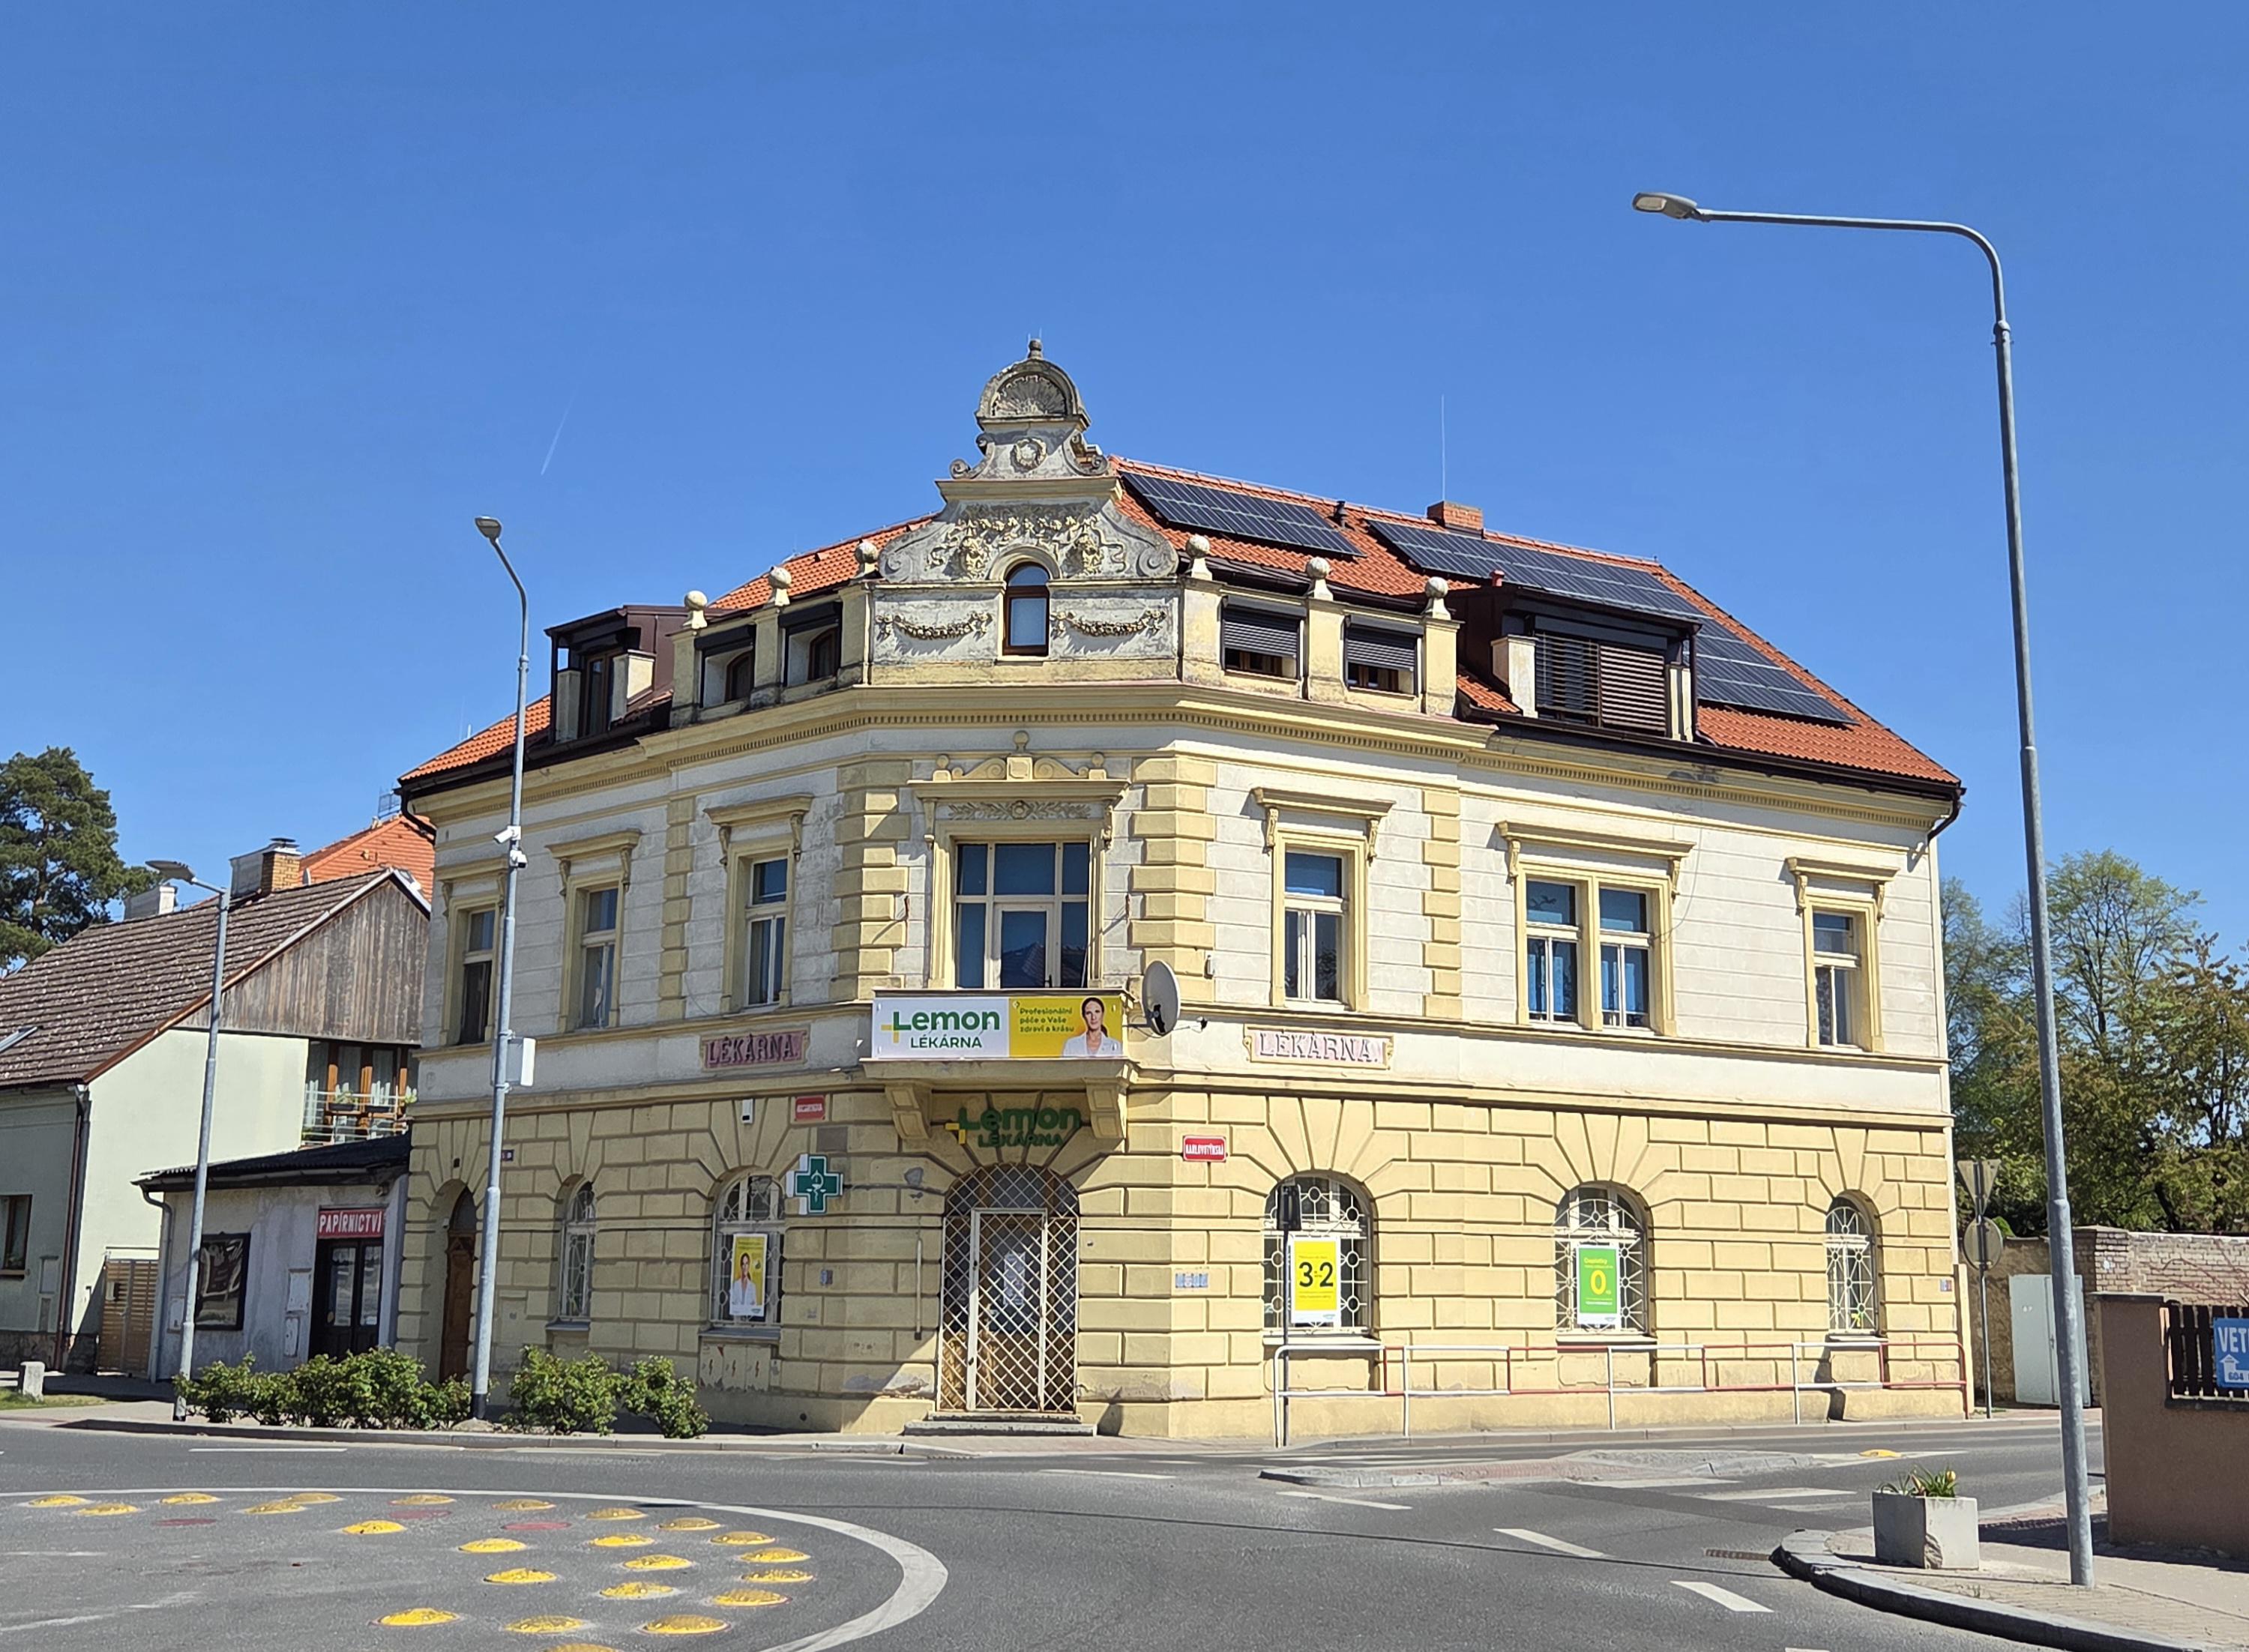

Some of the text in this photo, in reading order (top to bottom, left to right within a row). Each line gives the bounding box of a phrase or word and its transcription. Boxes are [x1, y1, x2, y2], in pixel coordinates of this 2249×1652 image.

[893, 1010, 1000, 1031] Lemon
[911, 1034, 982, 1048] LÉKÁRNA
[957, 1107, 1082, 1131] Lemon
[978, 1130, 1063, 1148] LÉKÁRNA
[319, 1211, 383, 1233] PAPÍRNICTVÍ
[1590, 1269, 1607, 1296] 0
[2218, 1327, 2249, 1354] VET
